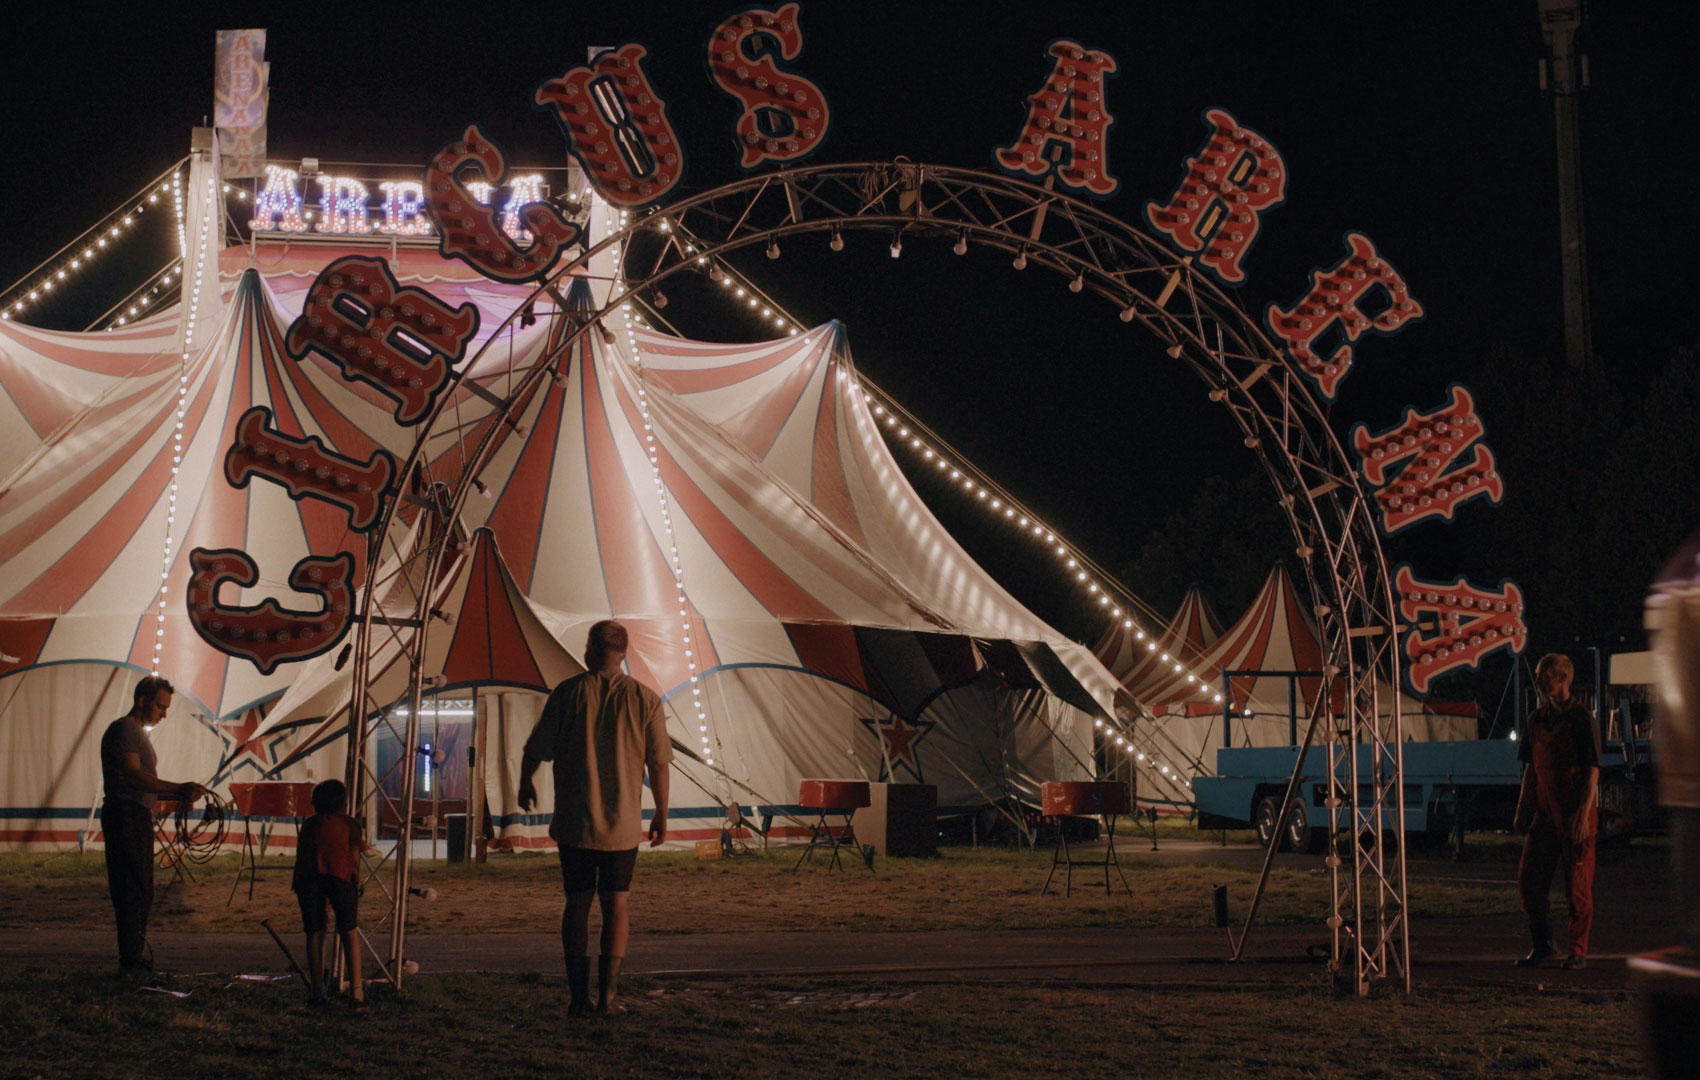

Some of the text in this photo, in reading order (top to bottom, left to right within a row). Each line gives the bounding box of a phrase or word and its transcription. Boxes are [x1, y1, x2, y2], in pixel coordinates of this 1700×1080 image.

[231, 35, 251, 124] ARENA
[188, 2, 1527, 694] CIRCUS ARENA
